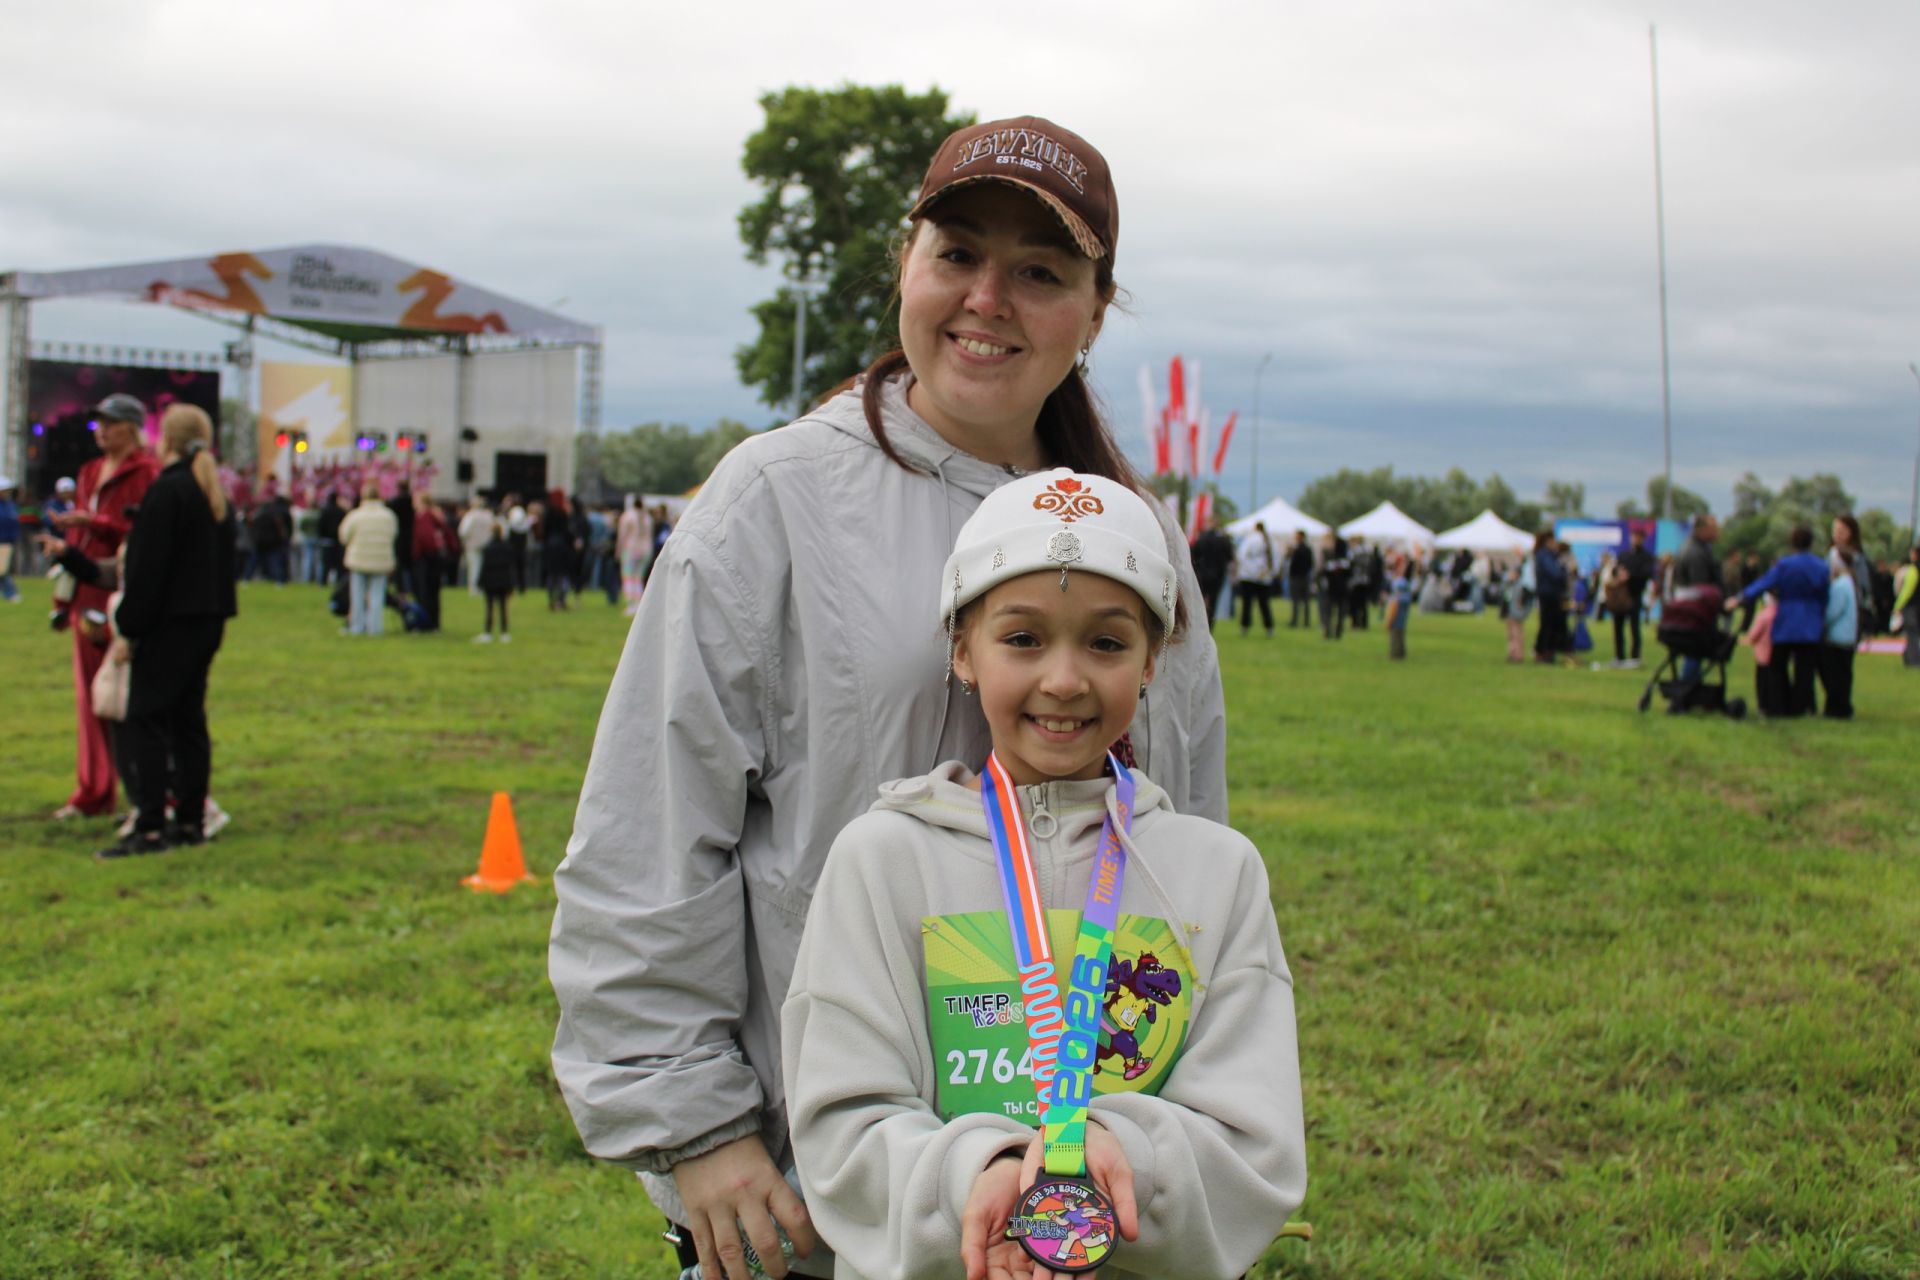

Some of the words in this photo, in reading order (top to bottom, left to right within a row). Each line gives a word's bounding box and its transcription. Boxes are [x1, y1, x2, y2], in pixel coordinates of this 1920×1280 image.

[953, 128, 1022, 172] NEW
[1019, 129, 1088, 194] YORK
[1050, 954, 1108, 1107] 2026
[946, 1047, 1035, 1085] 2764
[1003, 1101, 1023, 1114] ТЫ
